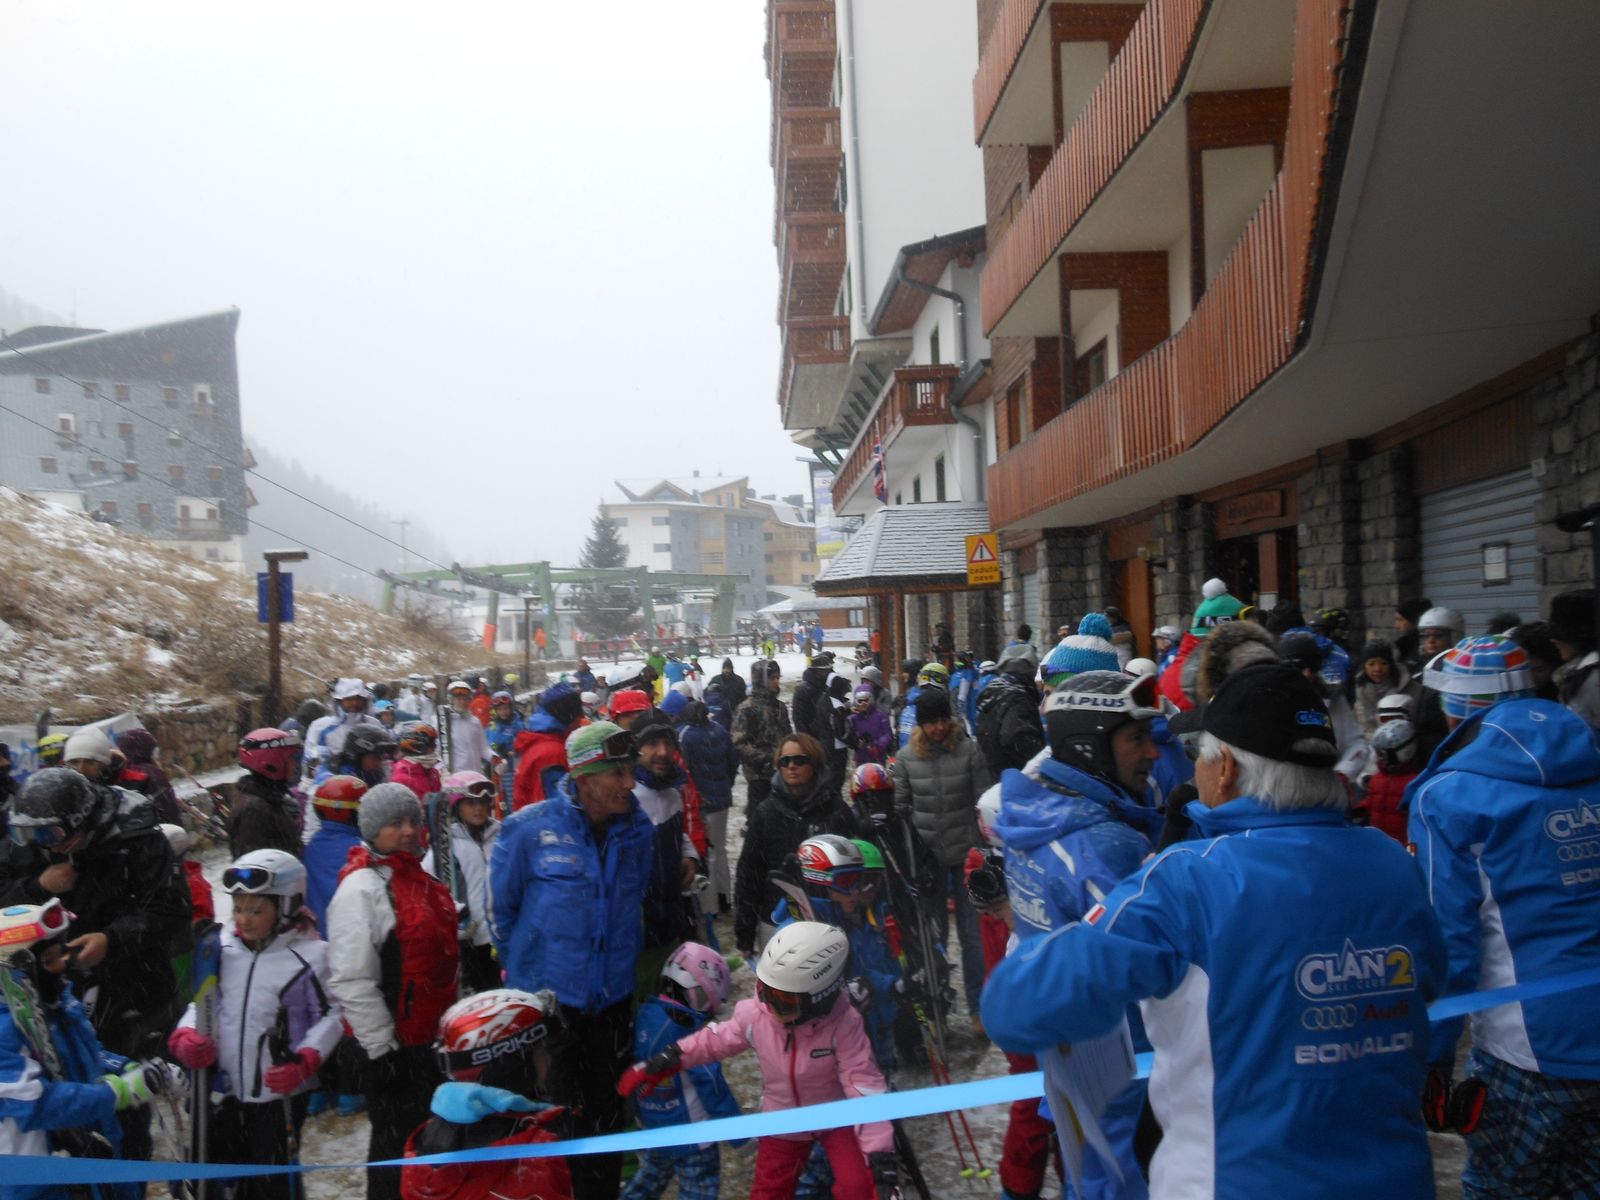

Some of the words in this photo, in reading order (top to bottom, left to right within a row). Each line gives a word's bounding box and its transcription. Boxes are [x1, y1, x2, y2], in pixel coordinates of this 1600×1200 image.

[1548, 805, 1600, 837] CLA
[1363, 1002, 1409, 1023] Audi
[472, 1024, 547, 1065] BRIKO
[1295, 1031, 1413, 1064] BONALDI
